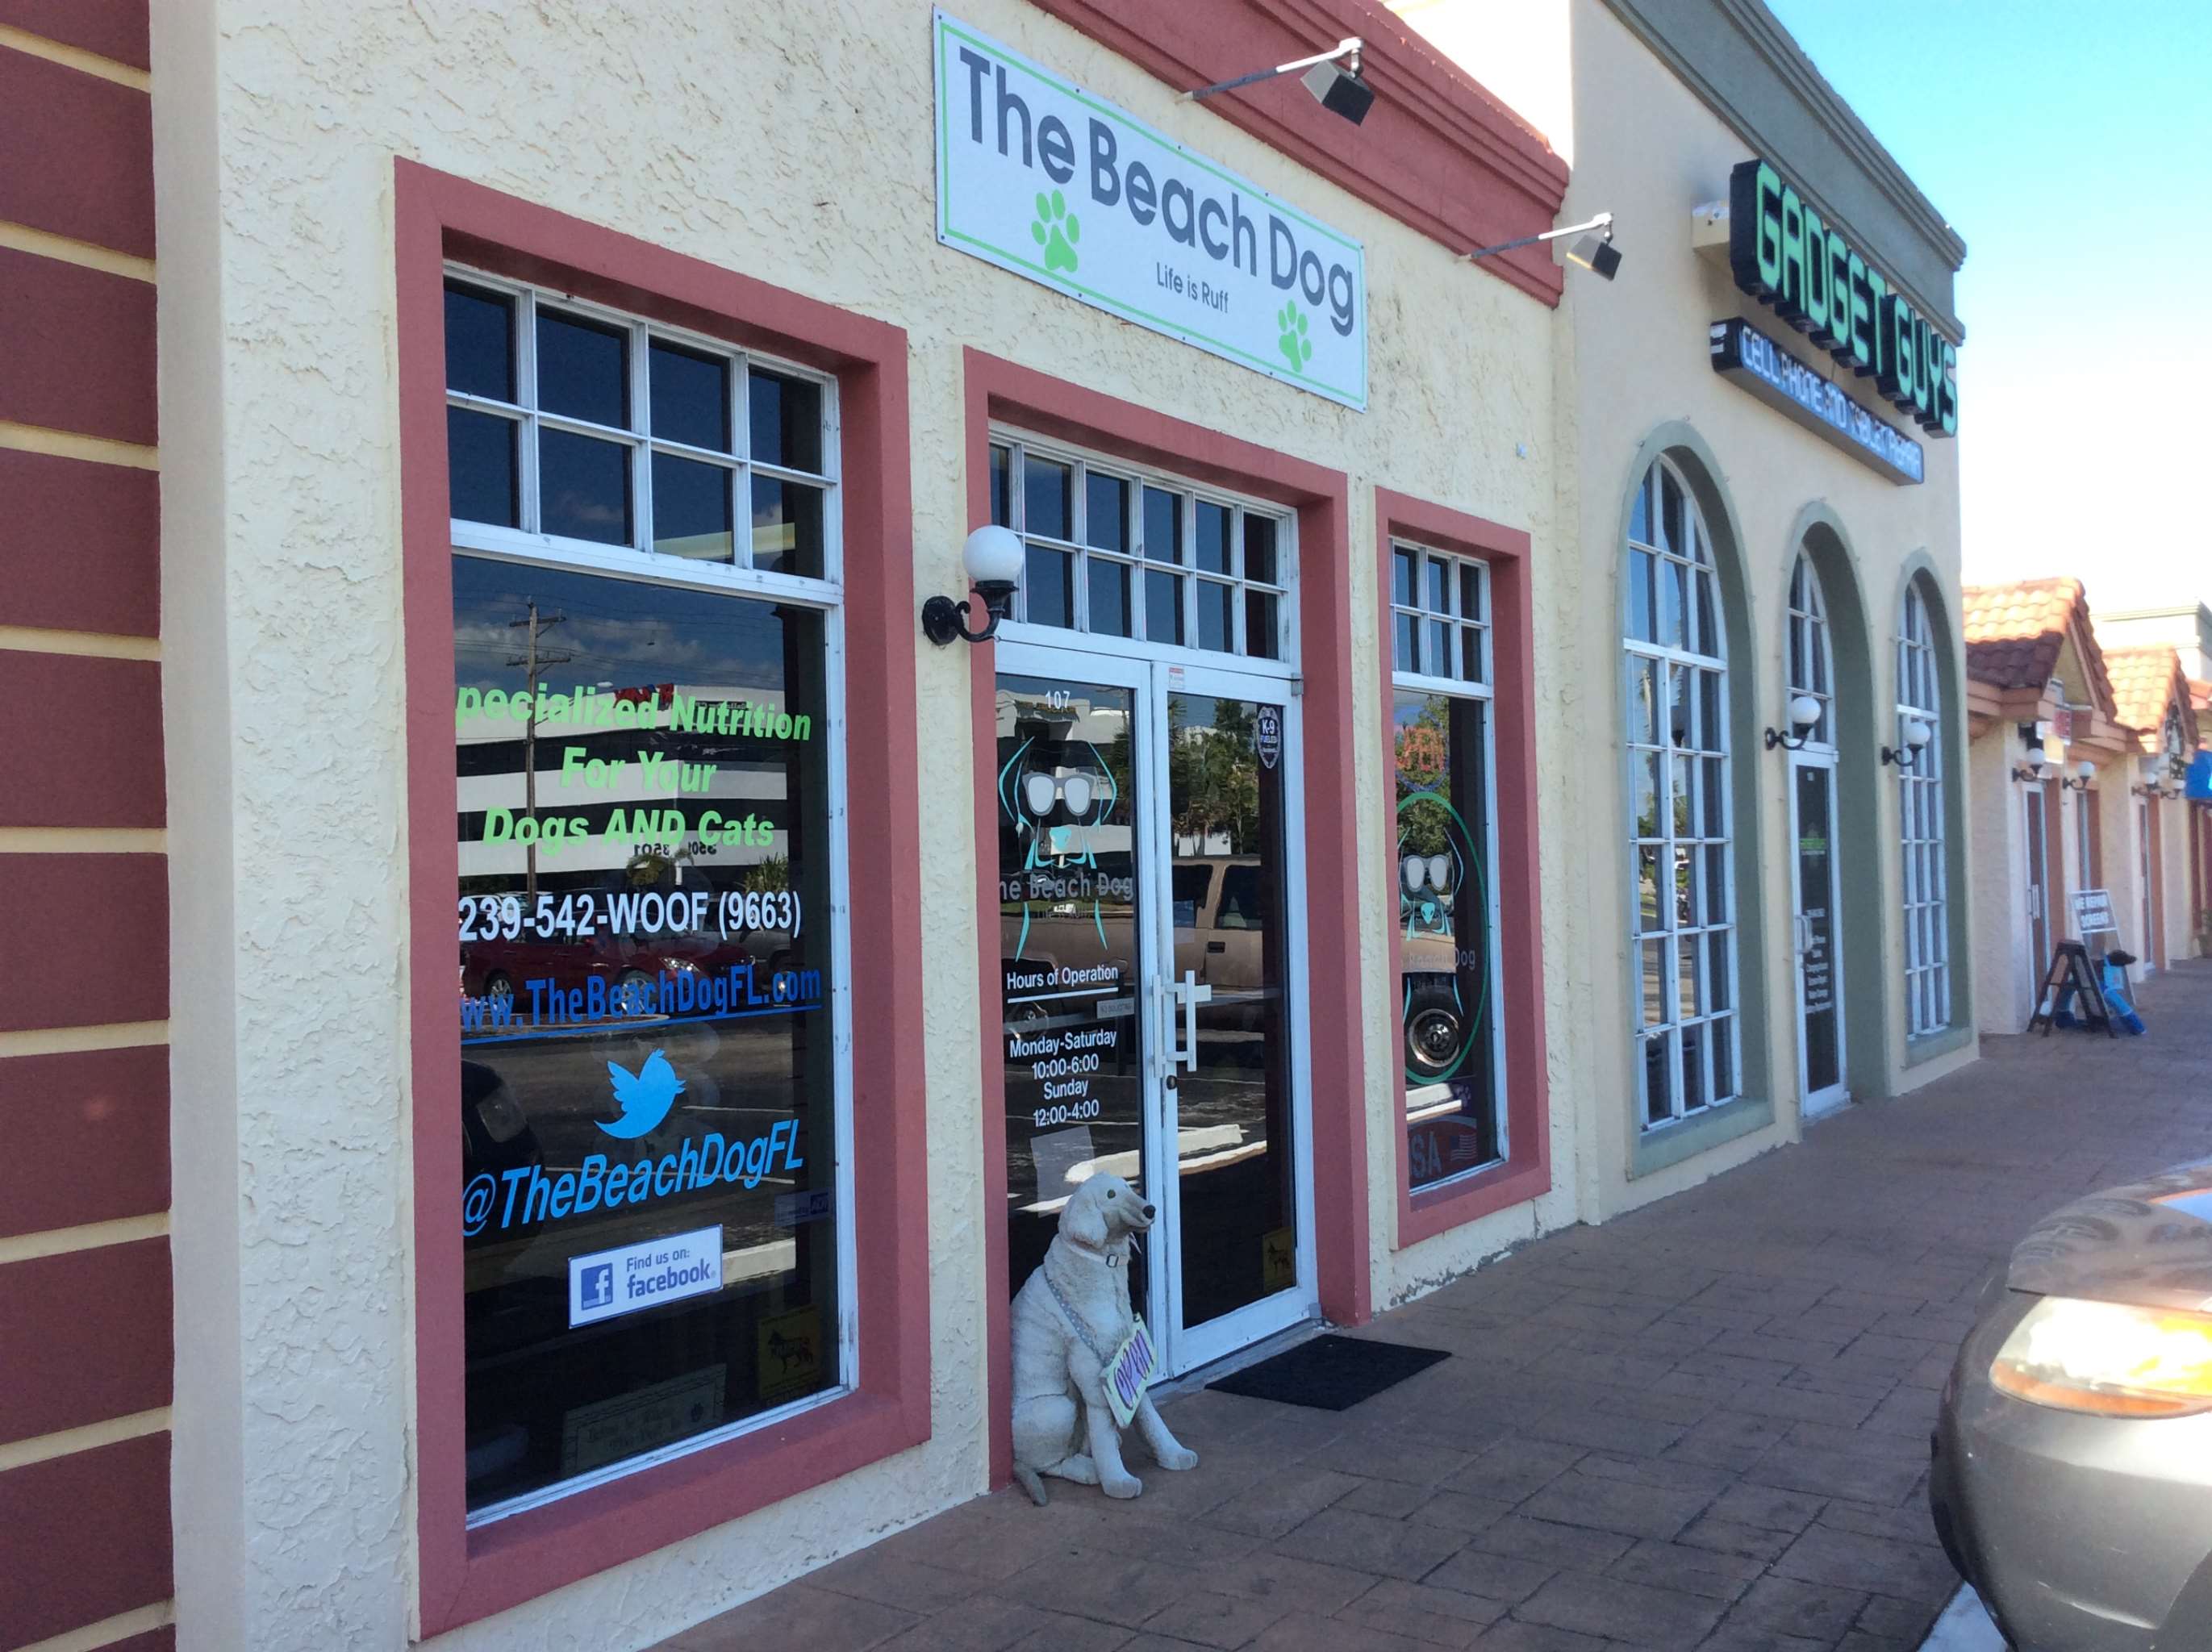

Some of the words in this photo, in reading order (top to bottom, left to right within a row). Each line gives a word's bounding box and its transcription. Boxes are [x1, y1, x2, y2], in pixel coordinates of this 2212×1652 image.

[959, 45, 1075, 185] The
[1089, 117, 1258, 277] Beach
[1269, 213, 1354, 338] Dog
[1156, 261, 1183, 294] Life
[1187, 274, 1198, 301] is
[1201, 281, 1229, 314] Ruff
[1756, 161, 1887, 375] GADGET
[1894, 297, 1958, 437] GUYS
[1742, 324, 1780, 385] CELL
[455, 682, 661, 730] pecialized
[669, 694, 812, 741] Nutrition
[1045, 690, 1071, 710] 107
[1262, 719, 1275, 735] K-9
[560, 746, 626, 789] For
[637, 749, 717, 793] Your
[482, 807, 590, 857] Dogs
[600, 807, 687, 845] AND
[698, 810, 774, 847] Cats
[1029, 870, 1091, 899] Beach
[1097, 872, 1133, 901] Dog
[458, 891, 709, 942] 239-542-WOOF
[719, 891, 801, 941] (9663)
[1006, 971, 1045, 990] Hours
[1046, 968, 1059, 985] of
[1062, 964, 1119, 987] Operation
[1453, 946, 1476, 970] Dog
[460, 963, 821, 1033] ww.TheBeachDogFL.com
[1009, 1028, 1117, 1058] Monday-Saturday
[1031, 1053, 1100, 1080] 10:00-6:00
[1043, 1078, 1089, 1100] Sunday
[1033, 1099, 1100, 1128] 12:00-4:00
[1409, 1129, 1442, 1179] SA
[461, 1119, 804, 1237] @TheBeachDogFL
[626, 1254, 652, 1272] Find
[656, 1253, 669, 1266] us
[672, 1248, 691, 1261] on:
[626, 1258, 711, 1299] facebook
